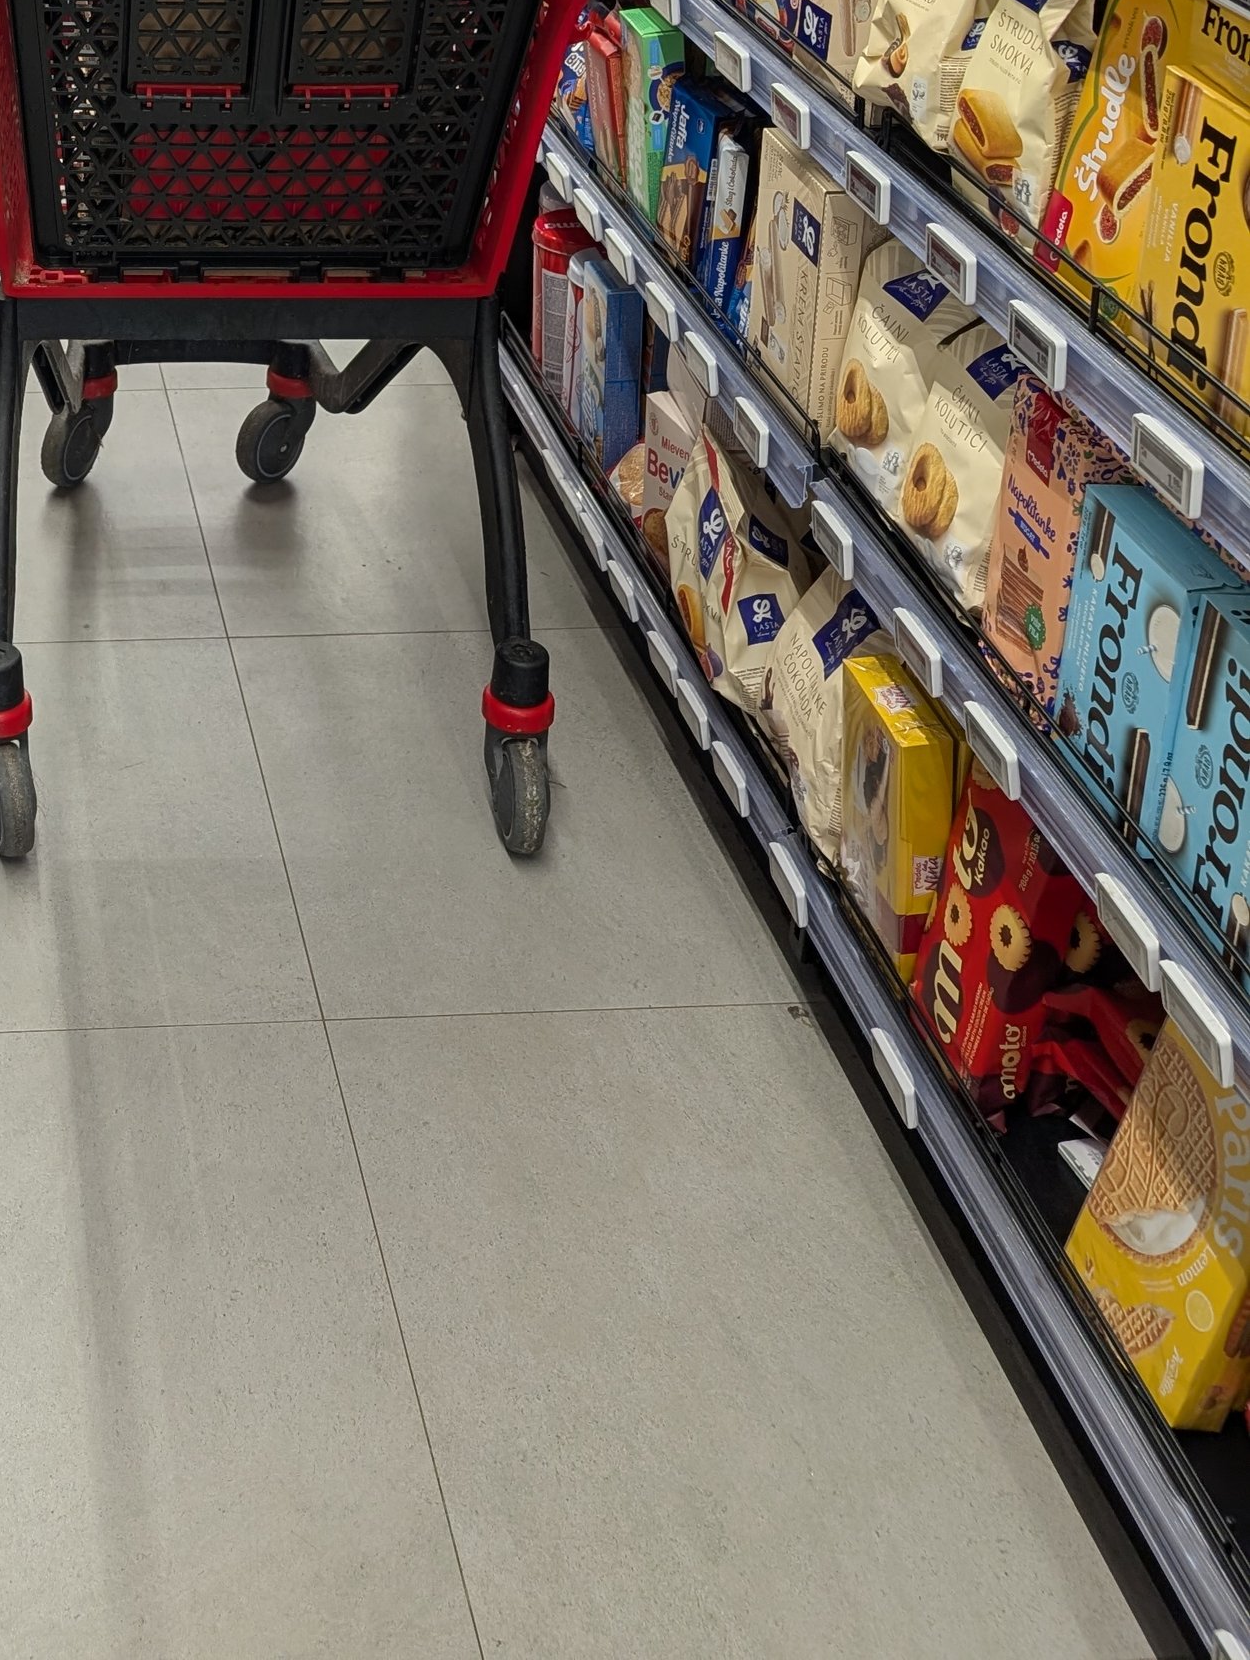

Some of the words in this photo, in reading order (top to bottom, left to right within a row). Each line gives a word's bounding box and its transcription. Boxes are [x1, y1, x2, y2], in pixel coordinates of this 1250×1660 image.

[817, 16, 825, 49] LASTA
[990, 35, 1034, 77] SMOKVA
[998, 8, 1044, 54] ŠTRUDLA
[1076, 51, 1136, 202] Štrudle
[1168, 115, 1237, 391] Frondi
[903, 272, 934, 304] LASTA
[870, 300, 909, 342] ČAJNI
[983, 352, 1011, 382] LASTA
[934, 398, 989, 455] KOLUTIĆI
[951, 383, 982, 423] ČAJNI
[1008, 475, 1056, 542] Napolitanke
[782, 654, 812, 720] ČOKOLADA
[791, 638, 826, 716] NAPOLITANKE
[1083, 542, 1142, 795] Frondi
[1194, 668, 1250, 924] Frondi
[974, 827, 991, 886] Kakao
[1179, 1241, 1218, 1287] Lemon
